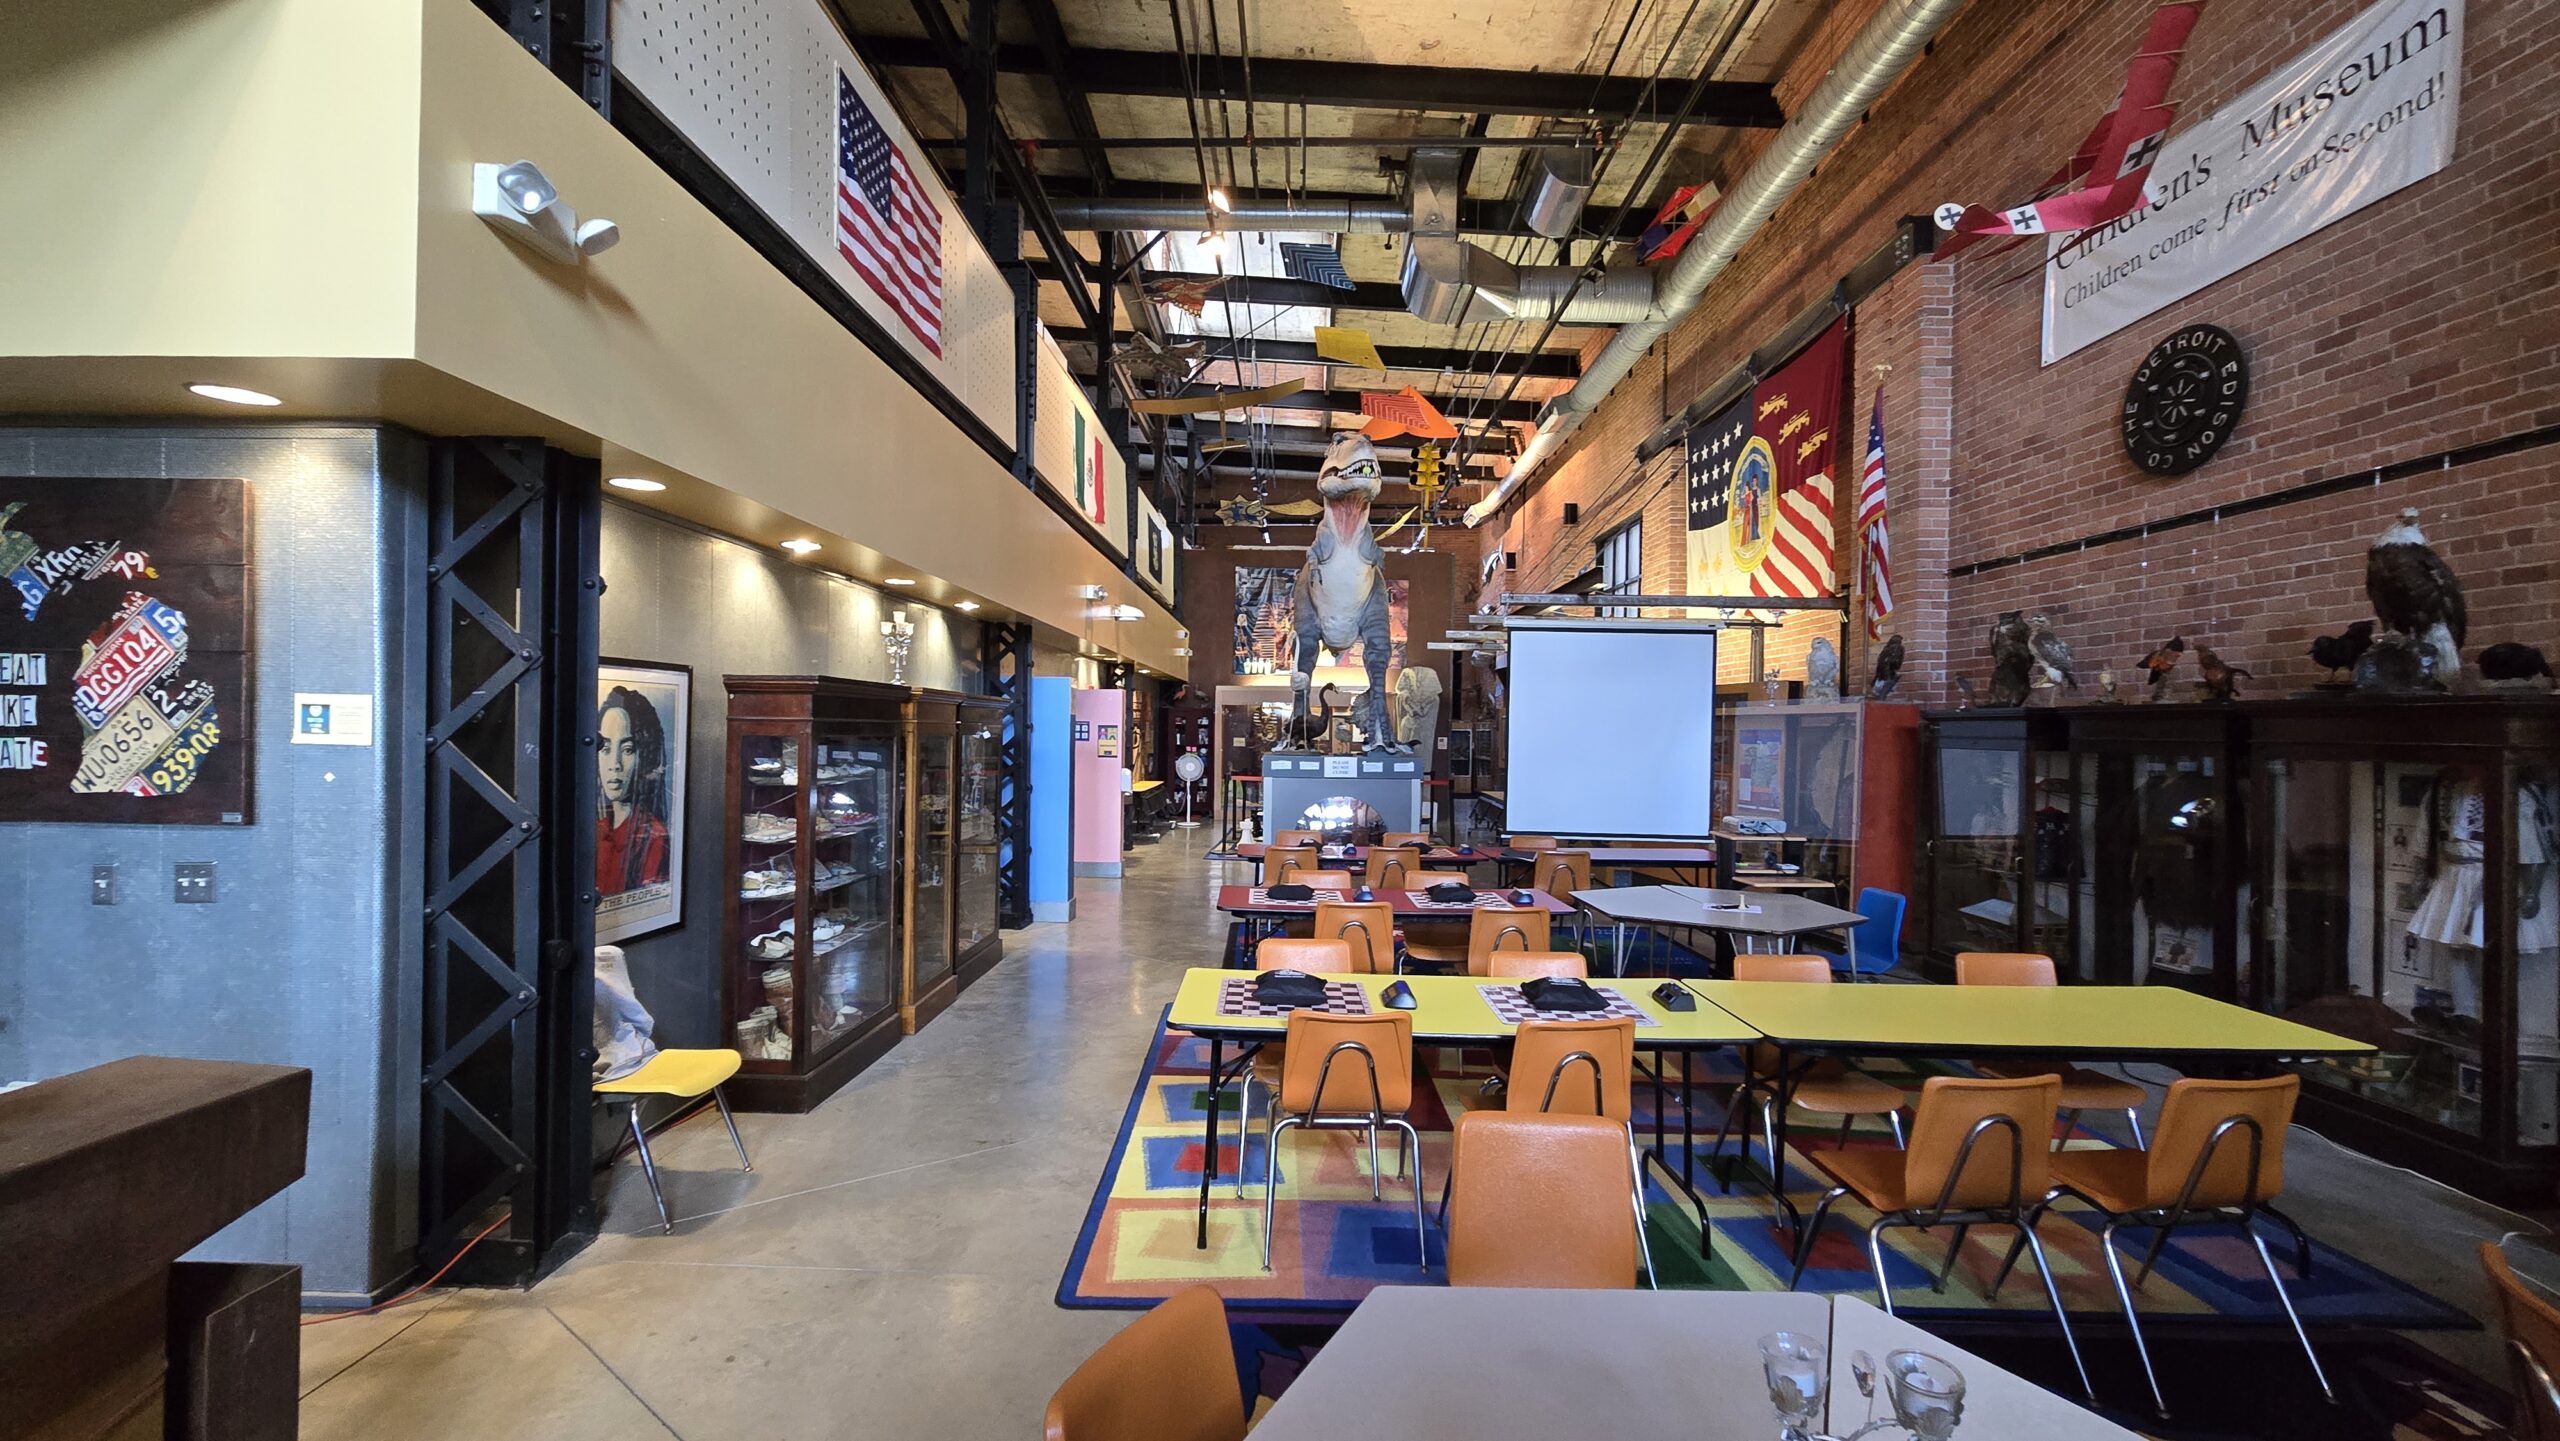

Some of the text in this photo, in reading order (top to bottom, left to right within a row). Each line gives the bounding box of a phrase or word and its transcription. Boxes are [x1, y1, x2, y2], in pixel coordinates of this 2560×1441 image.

[2239, 7, 2450, 161] Museum
[2064, 253, 2142, 309] Children
[2149, 217, 2207, 261] come
[2217, 173, 2280, 231] first
[2323, 71, 2446, 164] Second!
[2125, 401, 2140, 448] THE
[2137, 331, 2227, 382] DETROIT
[2187, 360, 2238, 459] EDISON
[75, 628, 157, 709] DGG104
[82, 637, 125, 679] MICHIGAN
[626, 887, 660, 903] PEOPLE
